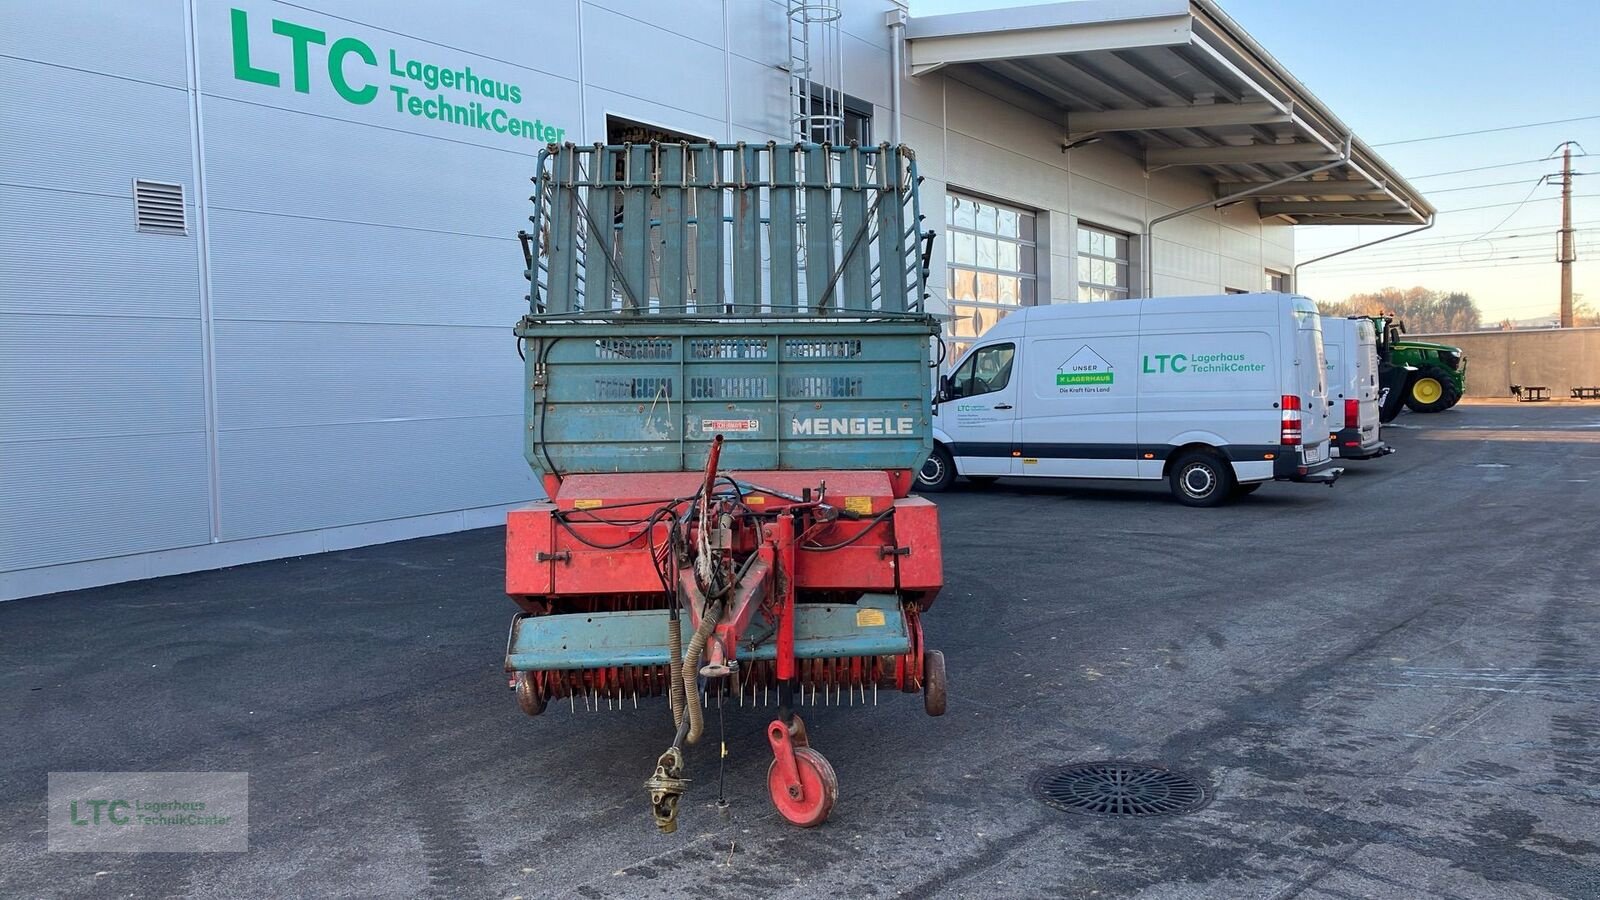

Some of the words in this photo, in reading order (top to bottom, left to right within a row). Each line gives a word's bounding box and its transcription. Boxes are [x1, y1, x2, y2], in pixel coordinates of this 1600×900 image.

[230, 8, 378, 105] LTC
[390, 48, 522, 104] Lagerhaus
[390, 85, 565, 144] TechnikCenter
[1143, 354, 1188, 374] LTC
[1191, 353, 1245, 364] Lagerhaus
[1191, 363, 1266, 373] TechnikCenter
[792, 417, 914, 435] MENGELE
